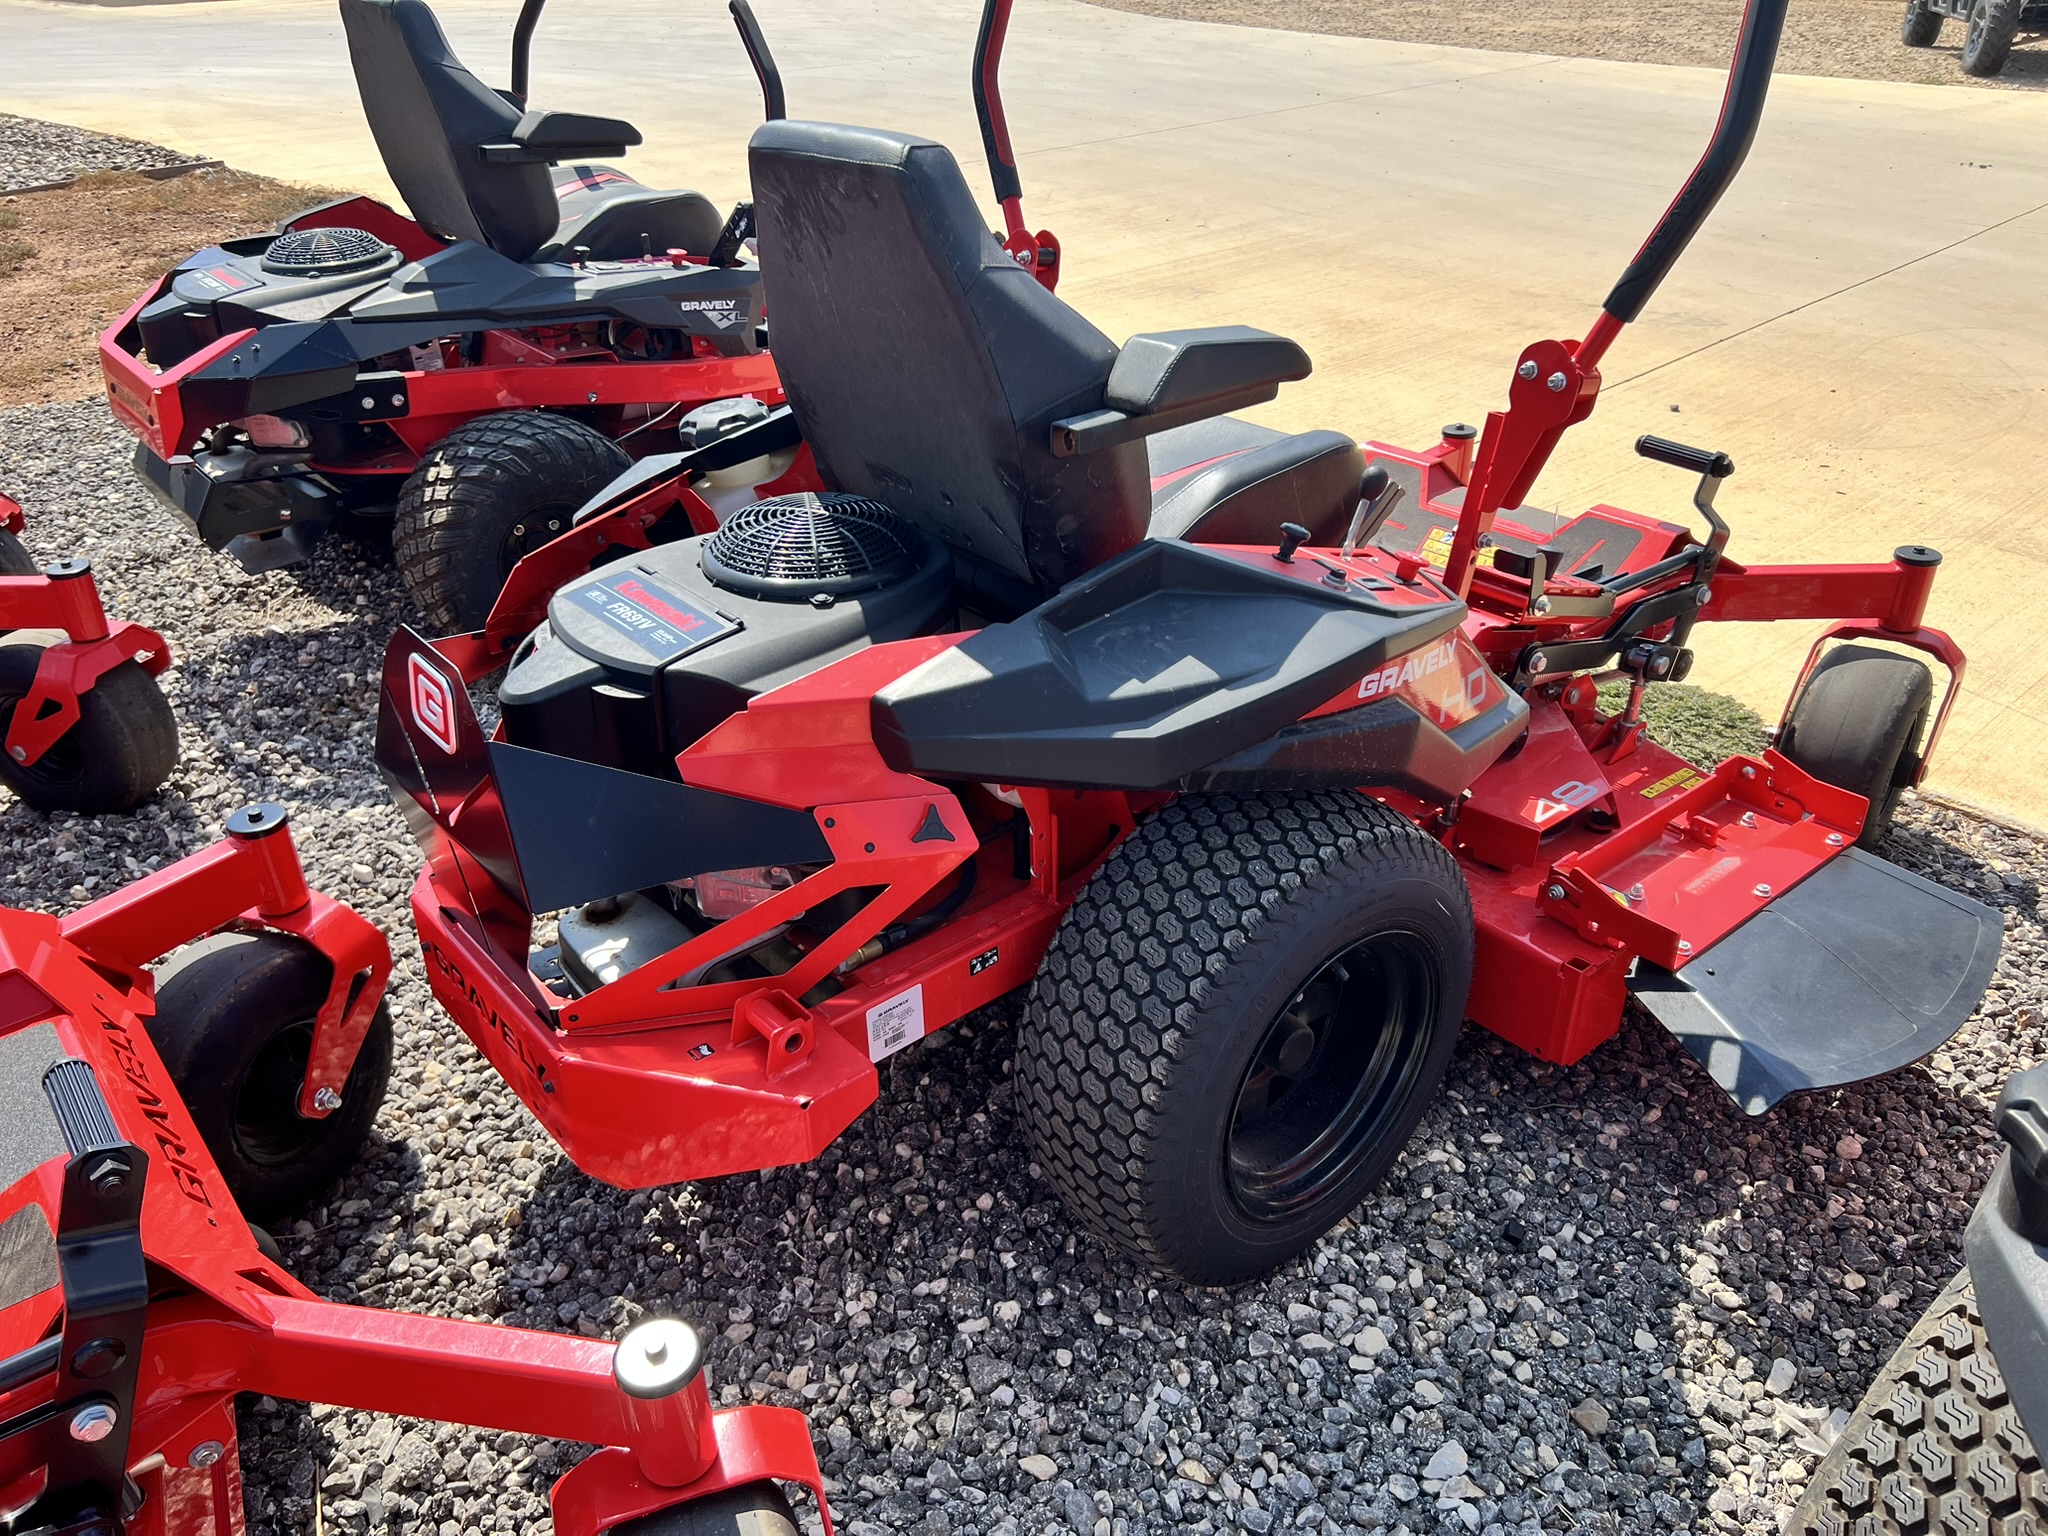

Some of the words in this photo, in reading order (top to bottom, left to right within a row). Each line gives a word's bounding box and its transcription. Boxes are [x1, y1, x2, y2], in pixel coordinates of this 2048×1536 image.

[681, 300, 736, 311] GRAVELY
[717, 311, 748, 322] XL
[606, 602, 657, 630] FR691V
[613, 579, 706, 633] Kawasaki
[1357, 637, 1457, 699] GRAVELY
[1534, 780, 1598, 823] 48
[432, 942, 547, 1083] GRAVELY
[91, 1002, 215, 1210] GRAVELY
